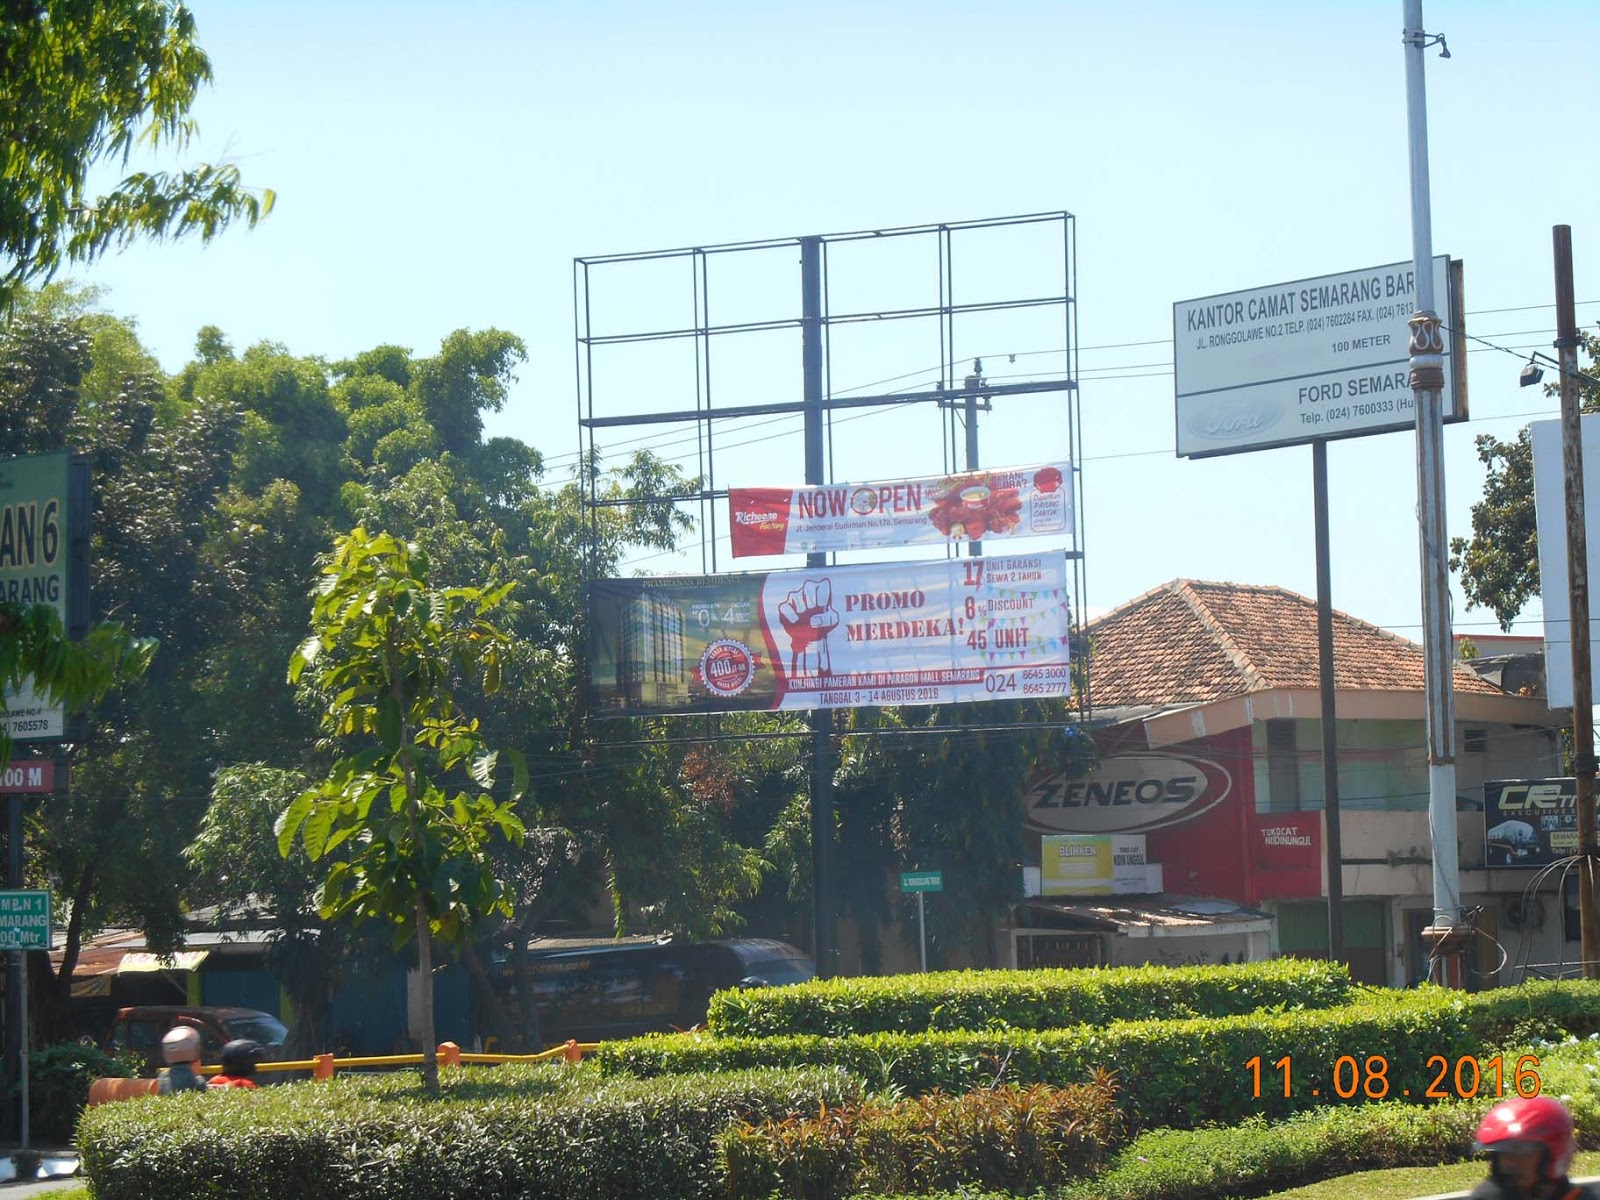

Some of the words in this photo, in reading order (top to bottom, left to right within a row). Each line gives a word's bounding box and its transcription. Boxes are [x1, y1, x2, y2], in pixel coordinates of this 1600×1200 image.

[1187, 302, 1244, 331] KANTOR
[1248, 292, 1296, 320] CAMAT
[1300, 277, 1381, 312] SEMARANG
[1386, 271, 1414, 298] BAR
[1197, 336, 1208, 350] JL.
[1209, 327, 1264, 348] RONGGOLAWE
[1265, 324, 1283, 338] NO.2
[1284, 320, 1305, 336] TELP.
[1306, 316, 1325, 333] (024)
[1326, 311, 1356, 329] 7602284
[1357, 308, 1375, 324] FAX.
[1376, 304, 1395, 322] (024)
[1396, 302, 1414, 316] 7613
[1332, 340, 1349, 354] 100
[1352, 334, 1391, 350] METER
[1298, 384, 1342, 404] FORD
[1300, 411, 1323, 424] Telp.
[1326, 406, 1350, 422] (024)
[1353, 402, 1394, 417] 7600333
[1396, 398, 1414, 412] (Hu
[798, 489, 847, 519] NOW
[850, 483, 922, 515] OPEN
[735, 511, 778, 524] Richeese
[804, 522, 834, 532] Jenderal
[834, 520, 866, 530] Sudirman
[893, 516, 928, 526] Semarang
[0, 503, 36, 566] AN
[42, 500, 58, 563] 6
[963, 560, 984, 587] 17
[986, 560, 1006, 572] UNIT
[1007, 558, 1042, 571] GARANSI
[986, 572, 1008, 584] SEWA
[1010, 572, 1016, 582] 2
[1017, 570, 1042, 582] TAHUN
[0, 574, 60, 602] ARANG
[845, 589, 925, 612] PROMO
[988, 598, 1034, 612] DISCOUNT
[846, 617, 964, 643] MERDEKA!
[966, 629, 987, 651] 45
[995, 627, 1029, 649] UNIT
[710, 659, 731, 677] 400
[789, 677, 822, 690] KUNJUNGI
[823, 676, 857, 689] PAMERAN
[858, 674, 876, 686] KAMI
[878, 674, 885, 684] DI
[887, 673, 919, 685] PARAGON
[920, 672, 939, 683] MALL
[941, 669, 980, 682] SEMARANG
[985, 673, 1017, 694] 024
[1022, 669, 1044, 680] 8645
[1045, 668, 1066, 679] 3000
[1023, 684, 1044, 695] 8645
[1046, 682, 1067, 693] 2777
[819, 691, 853, 705] TANGGAL
[855, 692, 860, 703] 3
[869, 691, 879, 703] 14
[881, 688, 916, 701] AGUSTUS
[918, 687, 939, 700] 2016
[13, 719, 49, 732] 7605578
[28, 767, 42, 786] M
[1031, 776, 1197, 809] ZENEOS
[35, 898, 42, 911] 1
[0, 914, 47, 927] MARANG
[0, 930, 15, 943] 00
